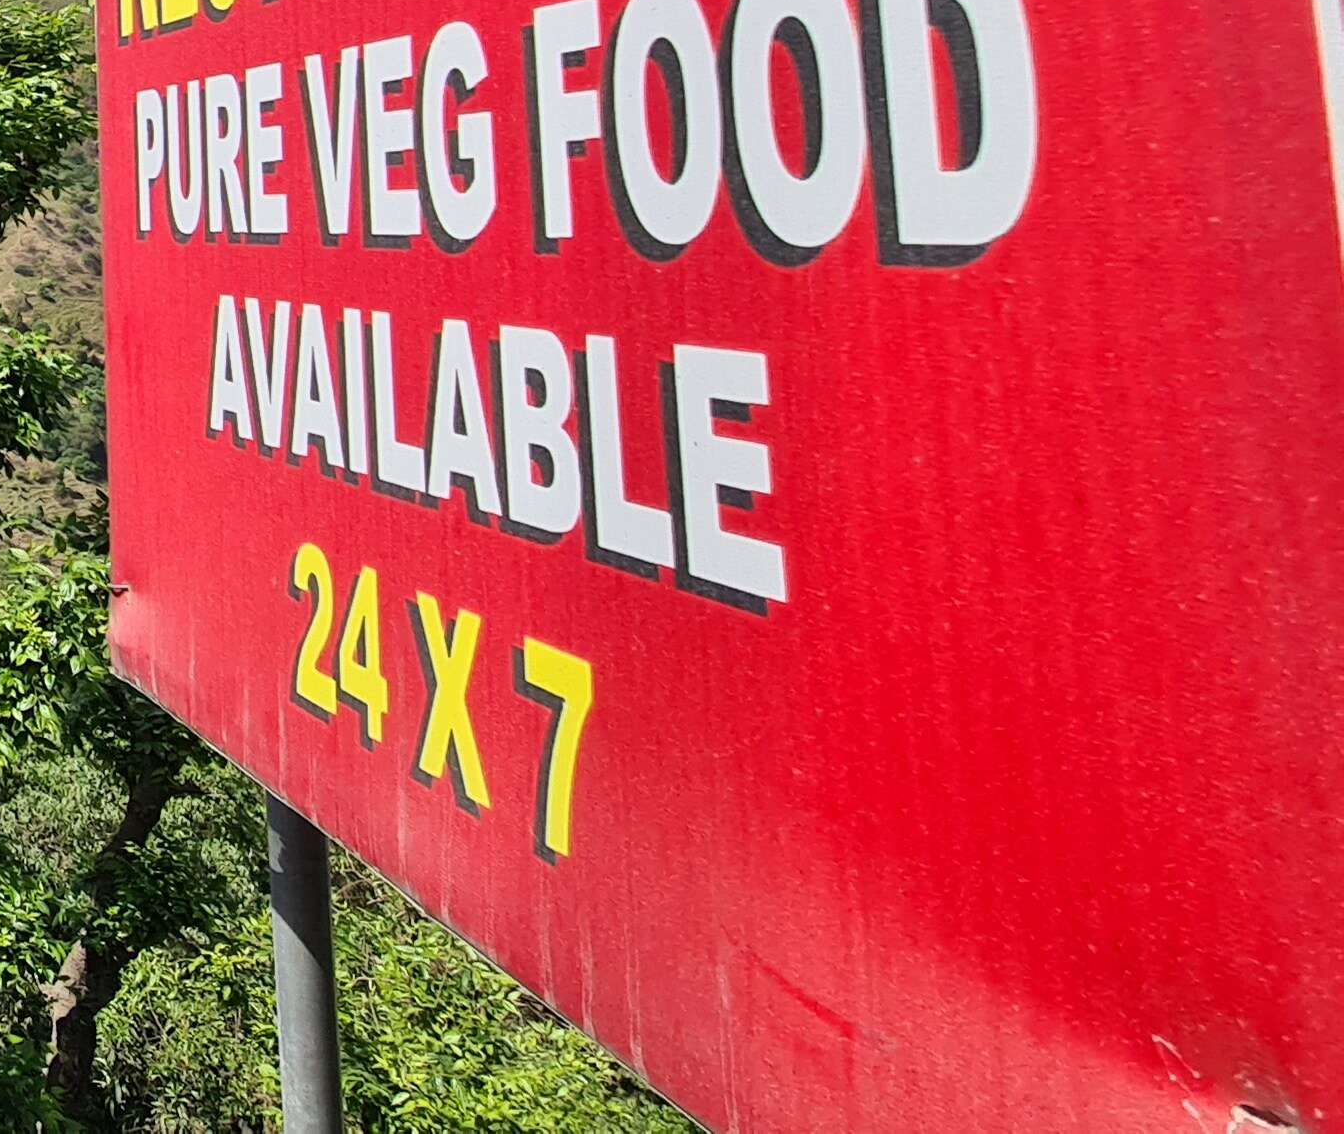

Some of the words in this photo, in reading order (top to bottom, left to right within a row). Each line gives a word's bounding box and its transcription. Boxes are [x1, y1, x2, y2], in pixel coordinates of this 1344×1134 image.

[134, 63, 288, 237] PURE
[304, 21, 498, 242] VEG
[209, 294, 789, 604] AVAILABLE
[294, 542, 390, 744] 24
[416, 591, 492, 809] X
[522, 636, 594, 856] 7
